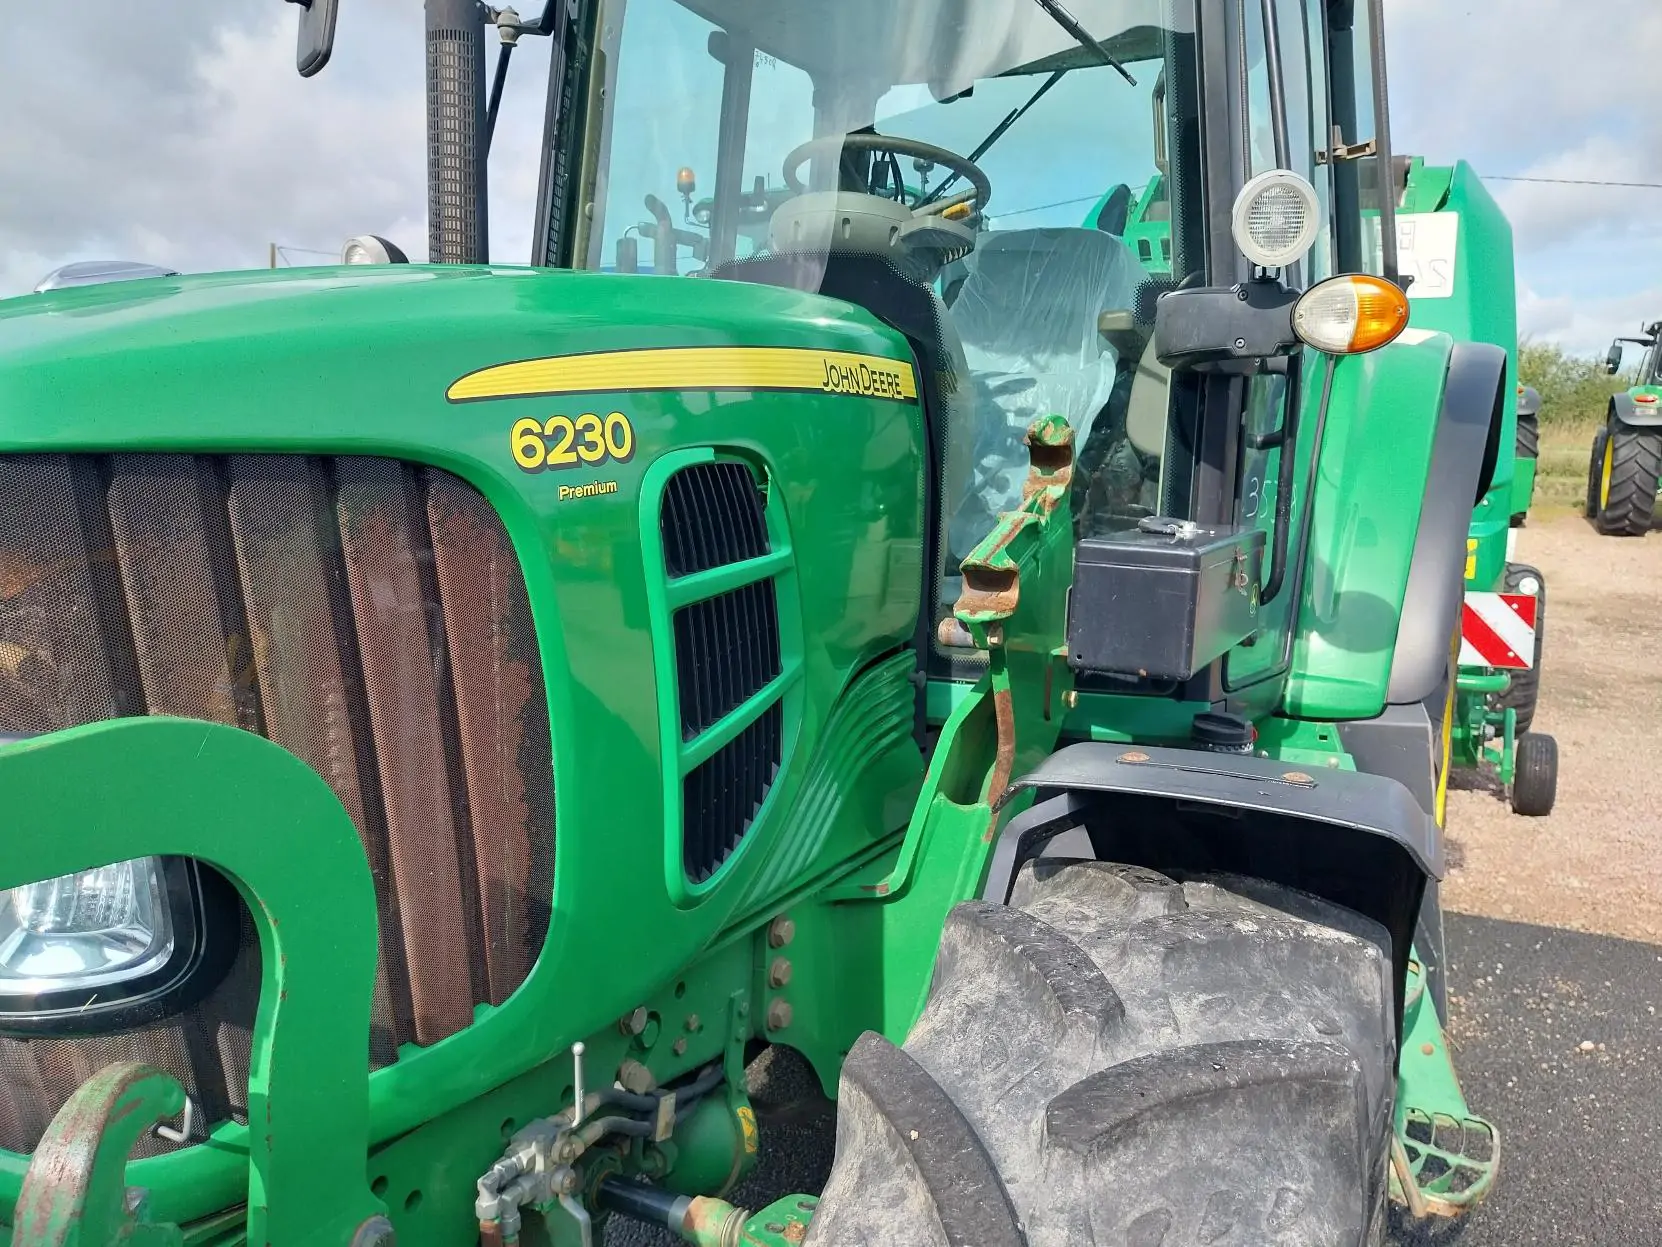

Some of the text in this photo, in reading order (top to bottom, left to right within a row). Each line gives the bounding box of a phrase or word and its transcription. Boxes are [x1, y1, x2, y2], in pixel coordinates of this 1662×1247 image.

[822, 358, 903, 396] JOHN DEERE
[510, 410, 636, 474] 6230
[558, 480, 618, 501] Premium
